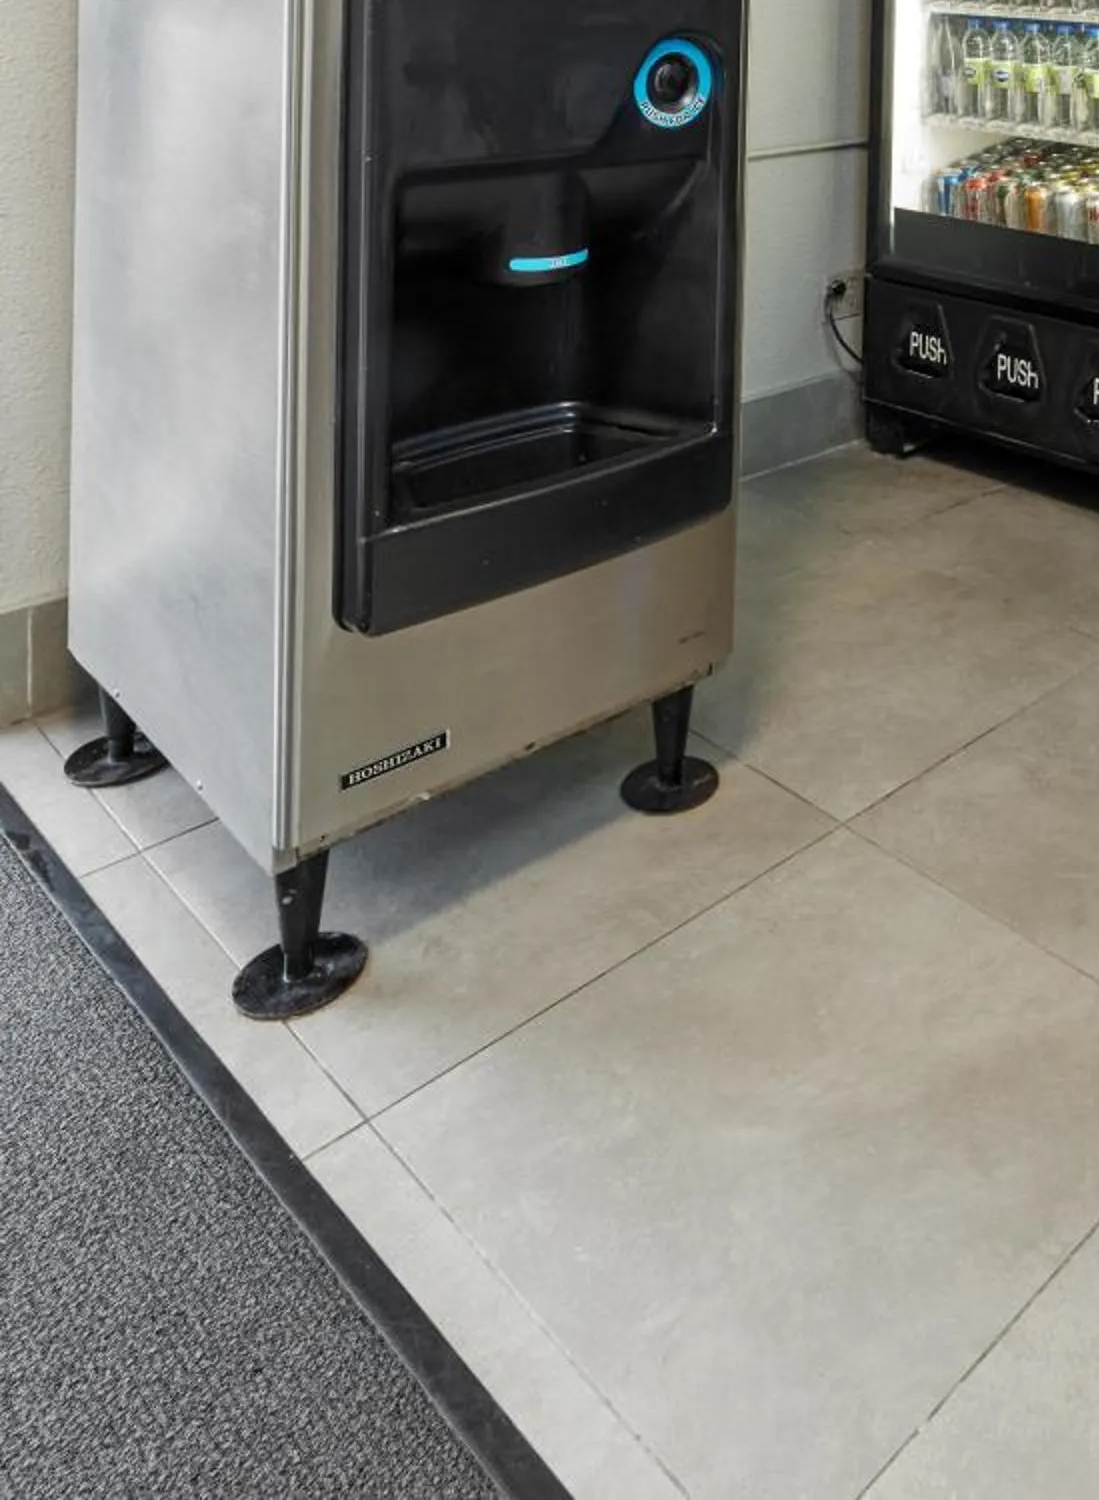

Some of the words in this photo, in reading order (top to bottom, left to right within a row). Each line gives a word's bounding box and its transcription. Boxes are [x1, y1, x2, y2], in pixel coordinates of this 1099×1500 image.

[909, 331, 947, 365] PUSH
[997, 353, 1039, 389] PUSH
[348, 737, 442, 785] HOSHIZAKI
